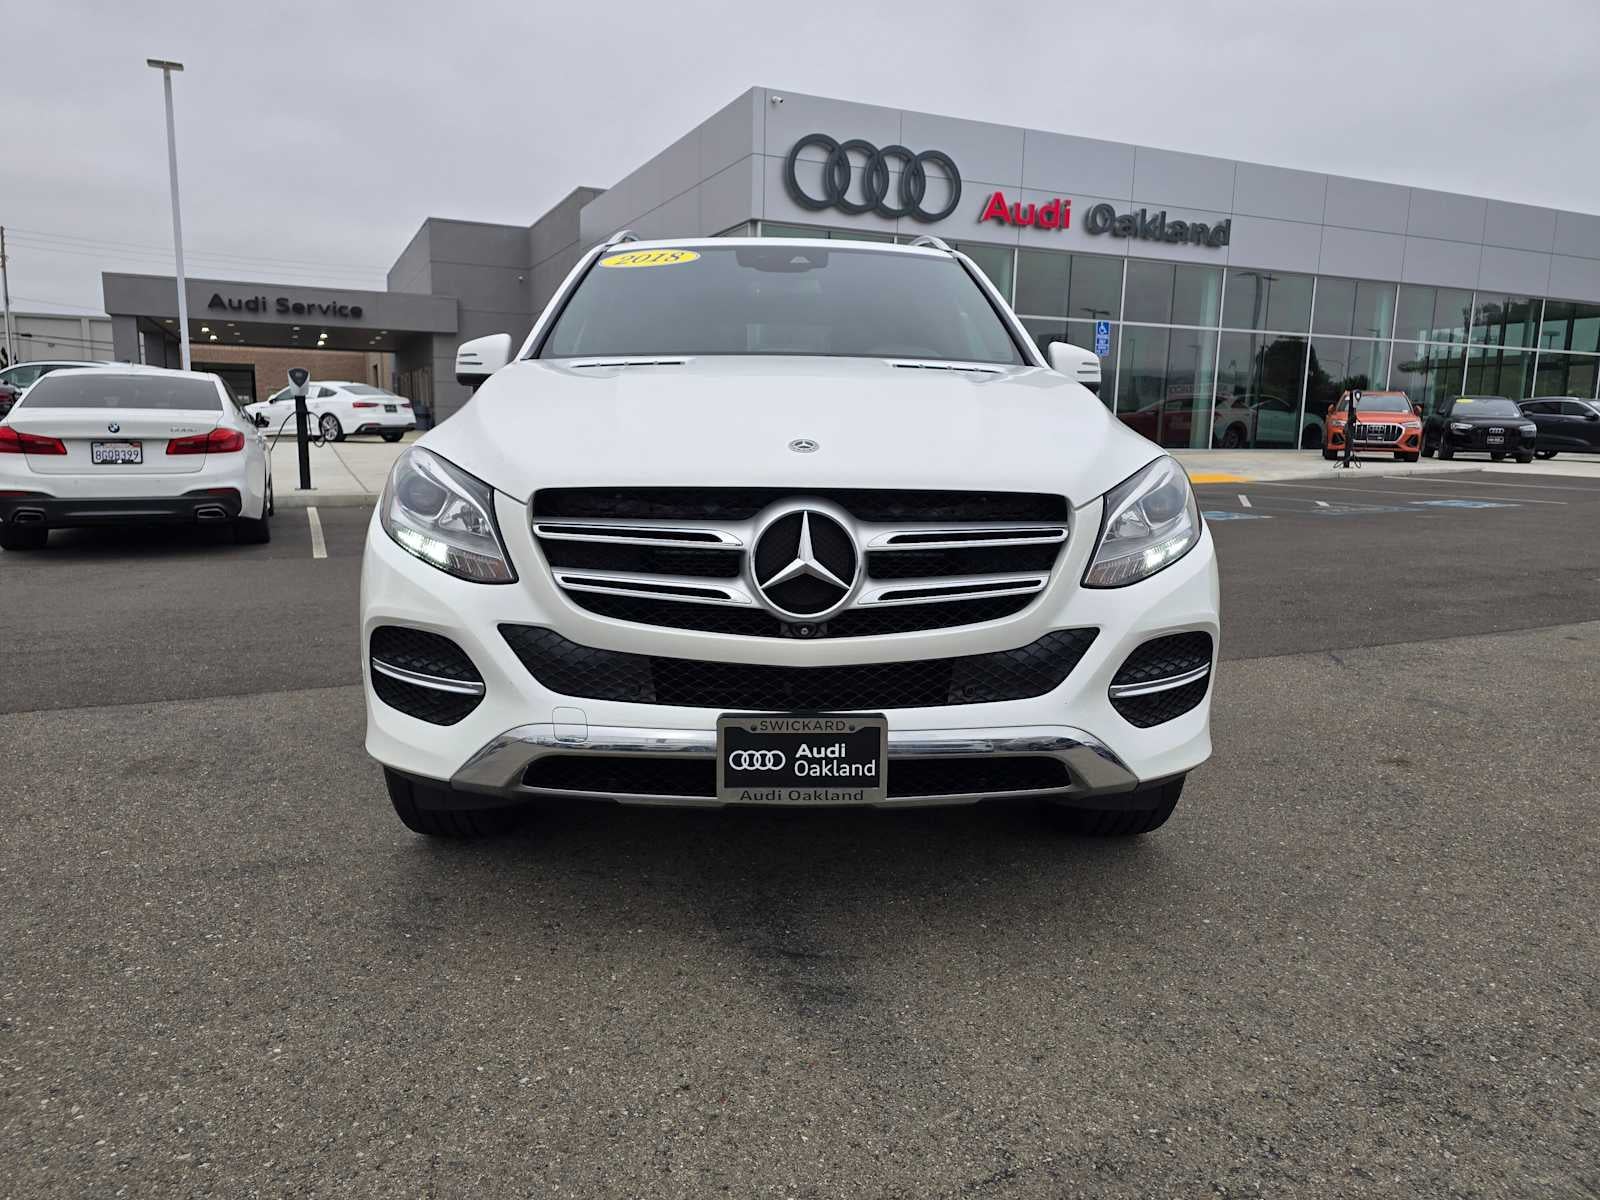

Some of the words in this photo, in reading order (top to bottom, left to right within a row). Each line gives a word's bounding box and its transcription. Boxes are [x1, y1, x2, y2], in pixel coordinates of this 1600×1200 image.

[980, 191, 1072, 229] Audi
[1087, 203, 1232, 248] Oakland
[615, 251, 686, 266] 2018
[208, 292, 267, 313] Audi
[275, 297, 363, 319] Service
[760, 720, 846, 731] SWICKARD
[795, 743, 846, 758] Audi
[794, 760, 876, 777] Oakland
[740, 790, 782, 801] Audi
[788, 790, 864, 801] Oakland
